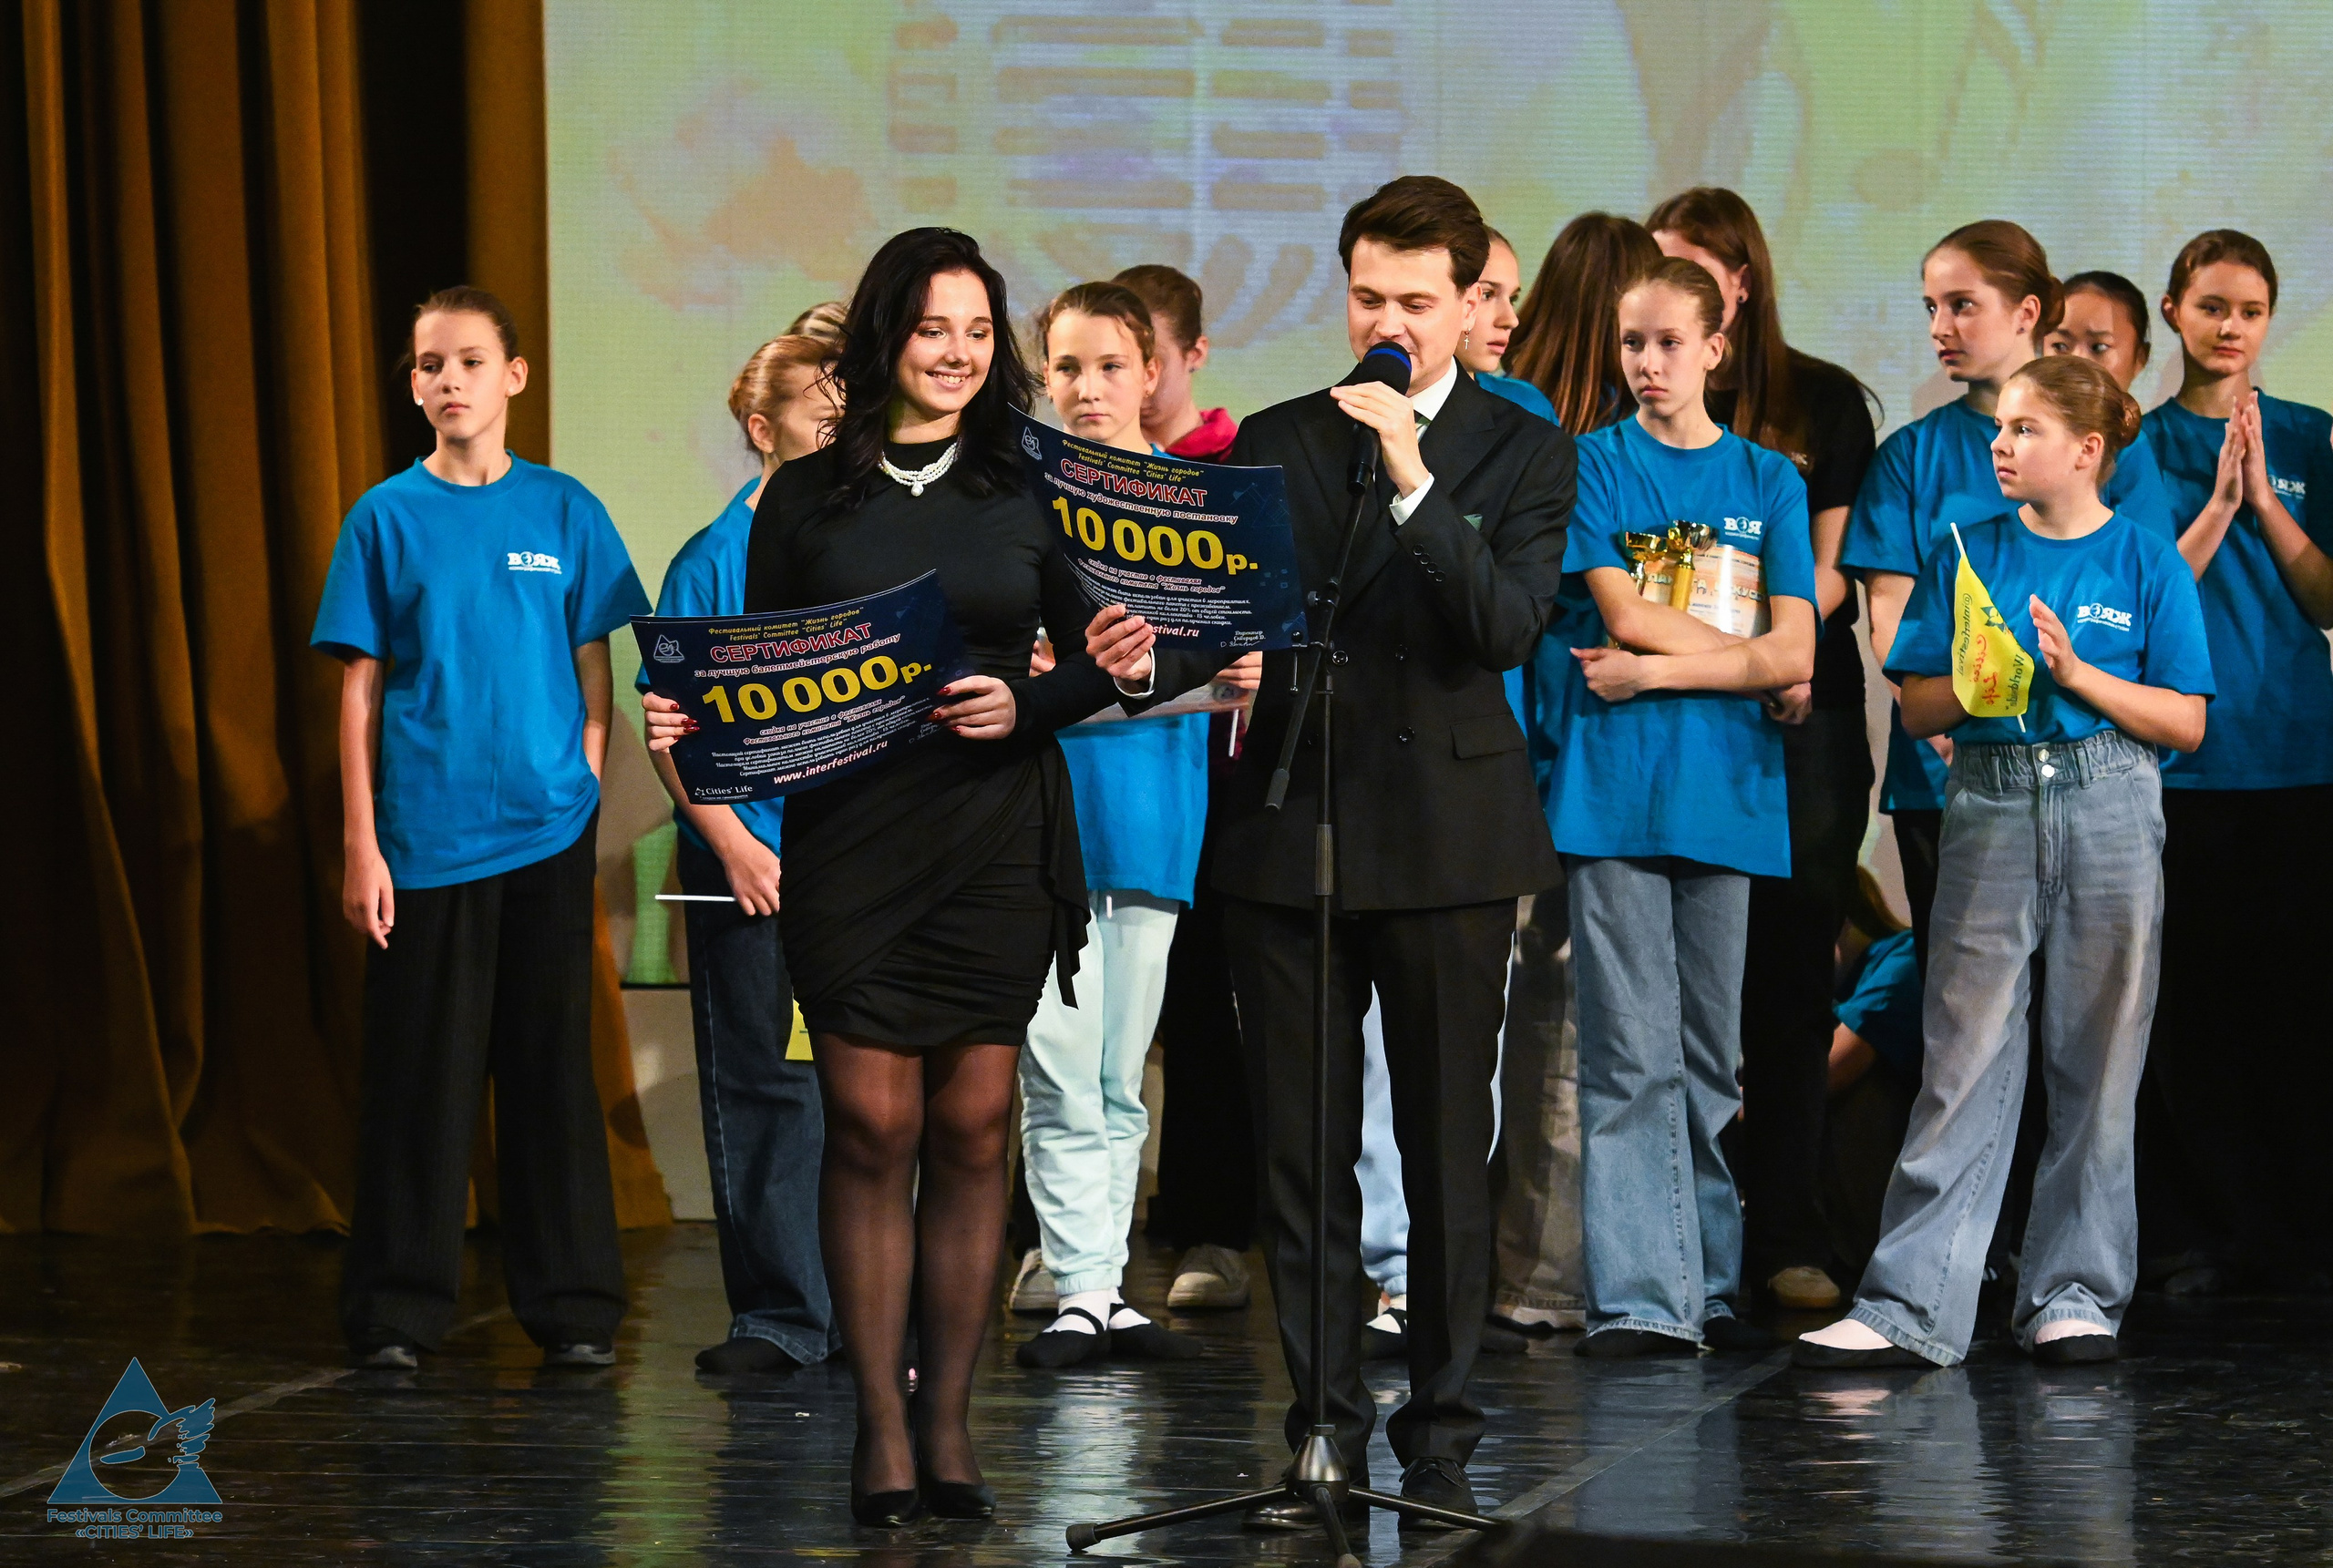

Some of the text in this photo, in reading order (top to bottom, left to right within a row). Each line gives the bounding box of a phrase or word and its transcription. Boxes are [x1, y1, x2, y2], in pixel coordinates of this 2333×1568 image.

[1063, 439, 1107, 458] Фестивальный
[1109, 456, 1141, 466] комитет
[1107, 461, 1140, 475] Committee
[1061, 458, 1208, 507] СЕРТИФИКАТ
[1044, 472, 1238, 525] за лучшую художественную постановку
[1088, 559, 1108, 571] скидка
[1118, 569, 1148, 579] участие
[1156, 575, 1202, 585] фестивалях
[1120, 579, 1158, 589] комитета
[709, 625, 762, 634] Фестивальный
[764, 621, 798, 630] комитет
[764, 629, 798, 638] Committee
[694, 633, 900, 679] за лучшую балетмейстерскую работу
[711, 622, 871, 663] СЕРТИФИКАТ
[760, 725, 786, 735] скидка
[798, 716, 829, 731] участие
[837, 699, 882, 719] фестивалях
[744, 731, 800, 745] Фестивального
[802, 720, 842, 735] комитета
[774, 741, 888, 784] www.interfestival.ru
